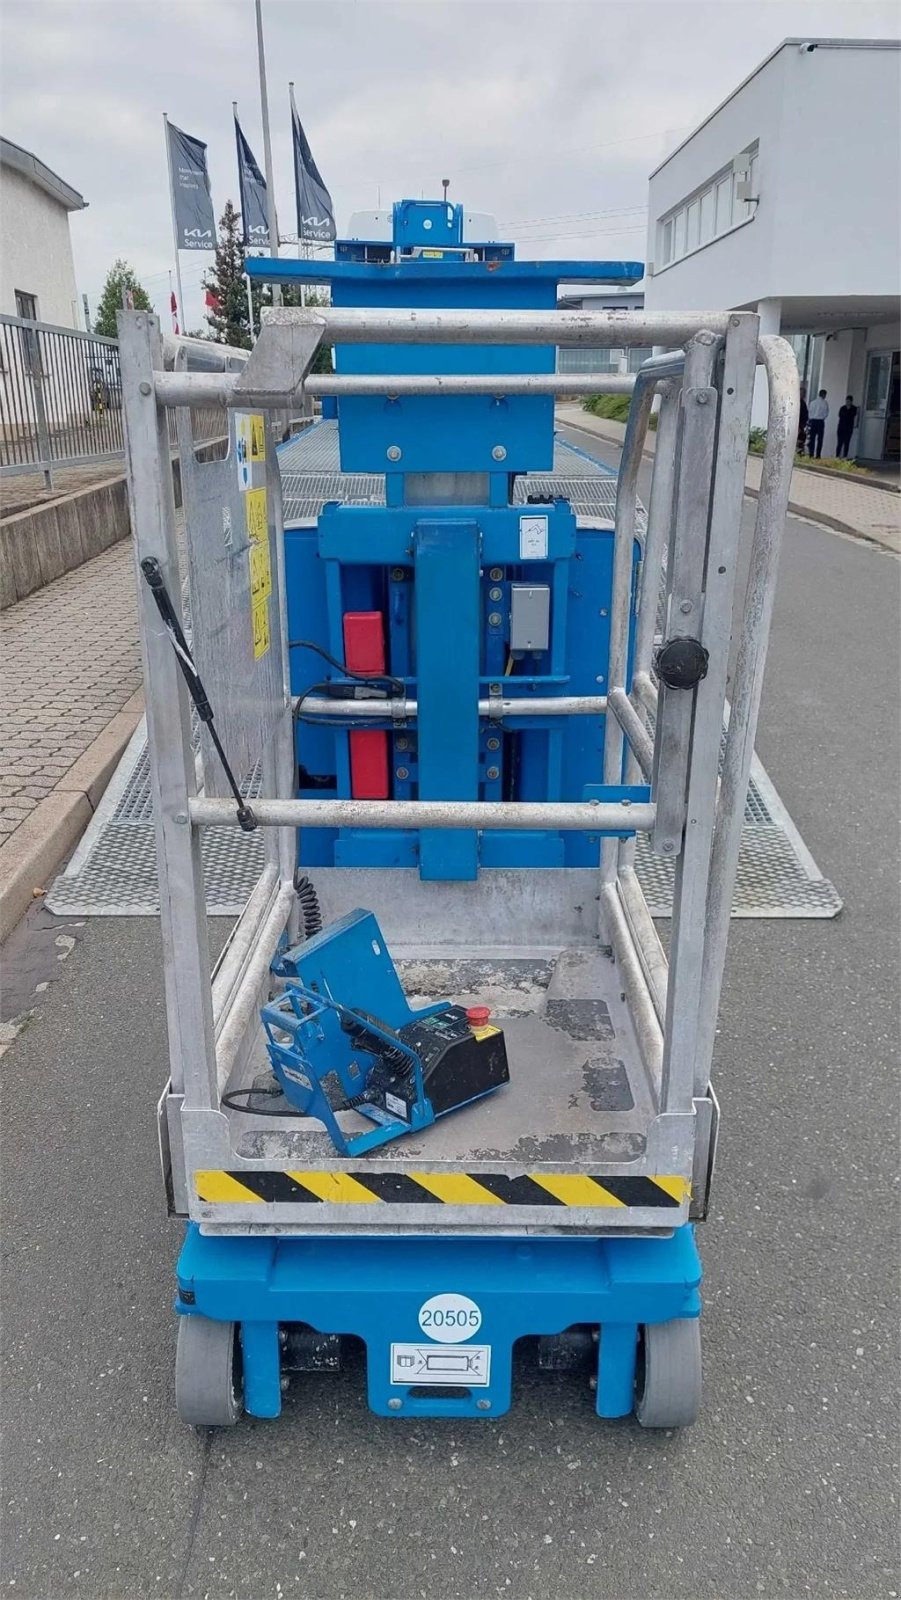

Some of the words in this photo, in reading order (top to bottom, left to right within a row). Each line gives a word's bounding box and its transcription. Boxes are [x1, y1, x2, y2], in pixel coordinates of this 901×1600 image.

[184, 228, 212, 238] KIA
[184, 238, 213, 249] Service
[421, 1310, 479, 1327] 20505
